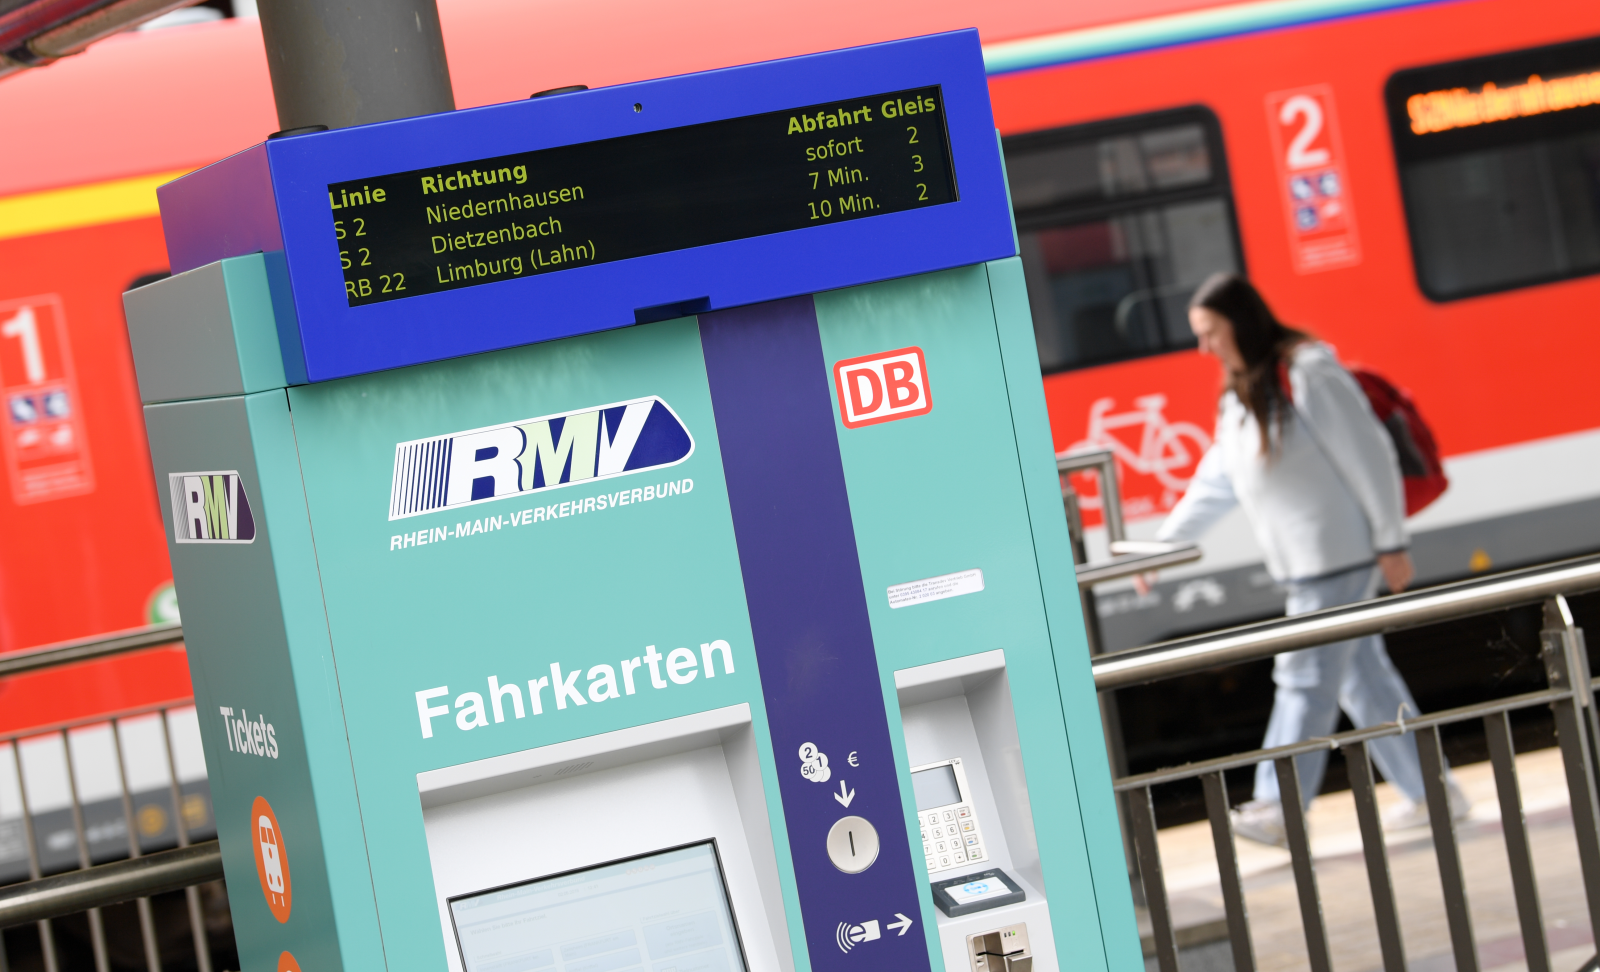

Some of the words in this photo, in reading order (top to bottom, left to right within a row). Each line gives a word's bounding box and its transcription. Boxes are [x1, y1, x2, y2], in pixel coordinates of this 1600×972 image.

[328, 185, 387, 210] Linie
[421, 164, 531, 197] Richtung
[787, 105, 873, 136] Abfahrt
[881, 95, 936, 119] Gleis
[1279, 94, 1330, 170] 2
[334, 220, 347, 240] S
[352, 217, 367, 237] 2
[426, 185, 585, 224] Niedernhausen
[805, 136, 864, 162] sofort
[906, 126, 919, 145] 2
[339, 250, 352, 270] S
[358, 247, 372, 267] 2
[431, 216, 563, 255] Dietzenbach
[808, 171, 820, 190] 7
[827, 166, 869, 187] Min.
[911, 154, 924, 173] 3
[344, 278, 373, 298] RB
[379, 272, 407, 294] 22
[436, 250, 523, 284] Limburg
[530, 239, 596, 270] (Lahn)
[807, 199, 832, 220] 10
[838, 193, 880, 215] Min.
[916, 183, 929, 201] 2
[2, 305, 45, 385] 1
[845, 360, 921, 417] DB
[446, 399, 656, 507] RMV
[183, 474, 239, 540] RMV
[390, 478, 694, 551] RHEIN-MAIN-VERKEHRSVERBUND
[415, 639, 735, 739] Fahrkarten
[219, 706, 279, 760] Tickets
[803, 764, 815, 776] 50
[804, 746, 813, 759] 2
[816, 755, 823, 768] 1
